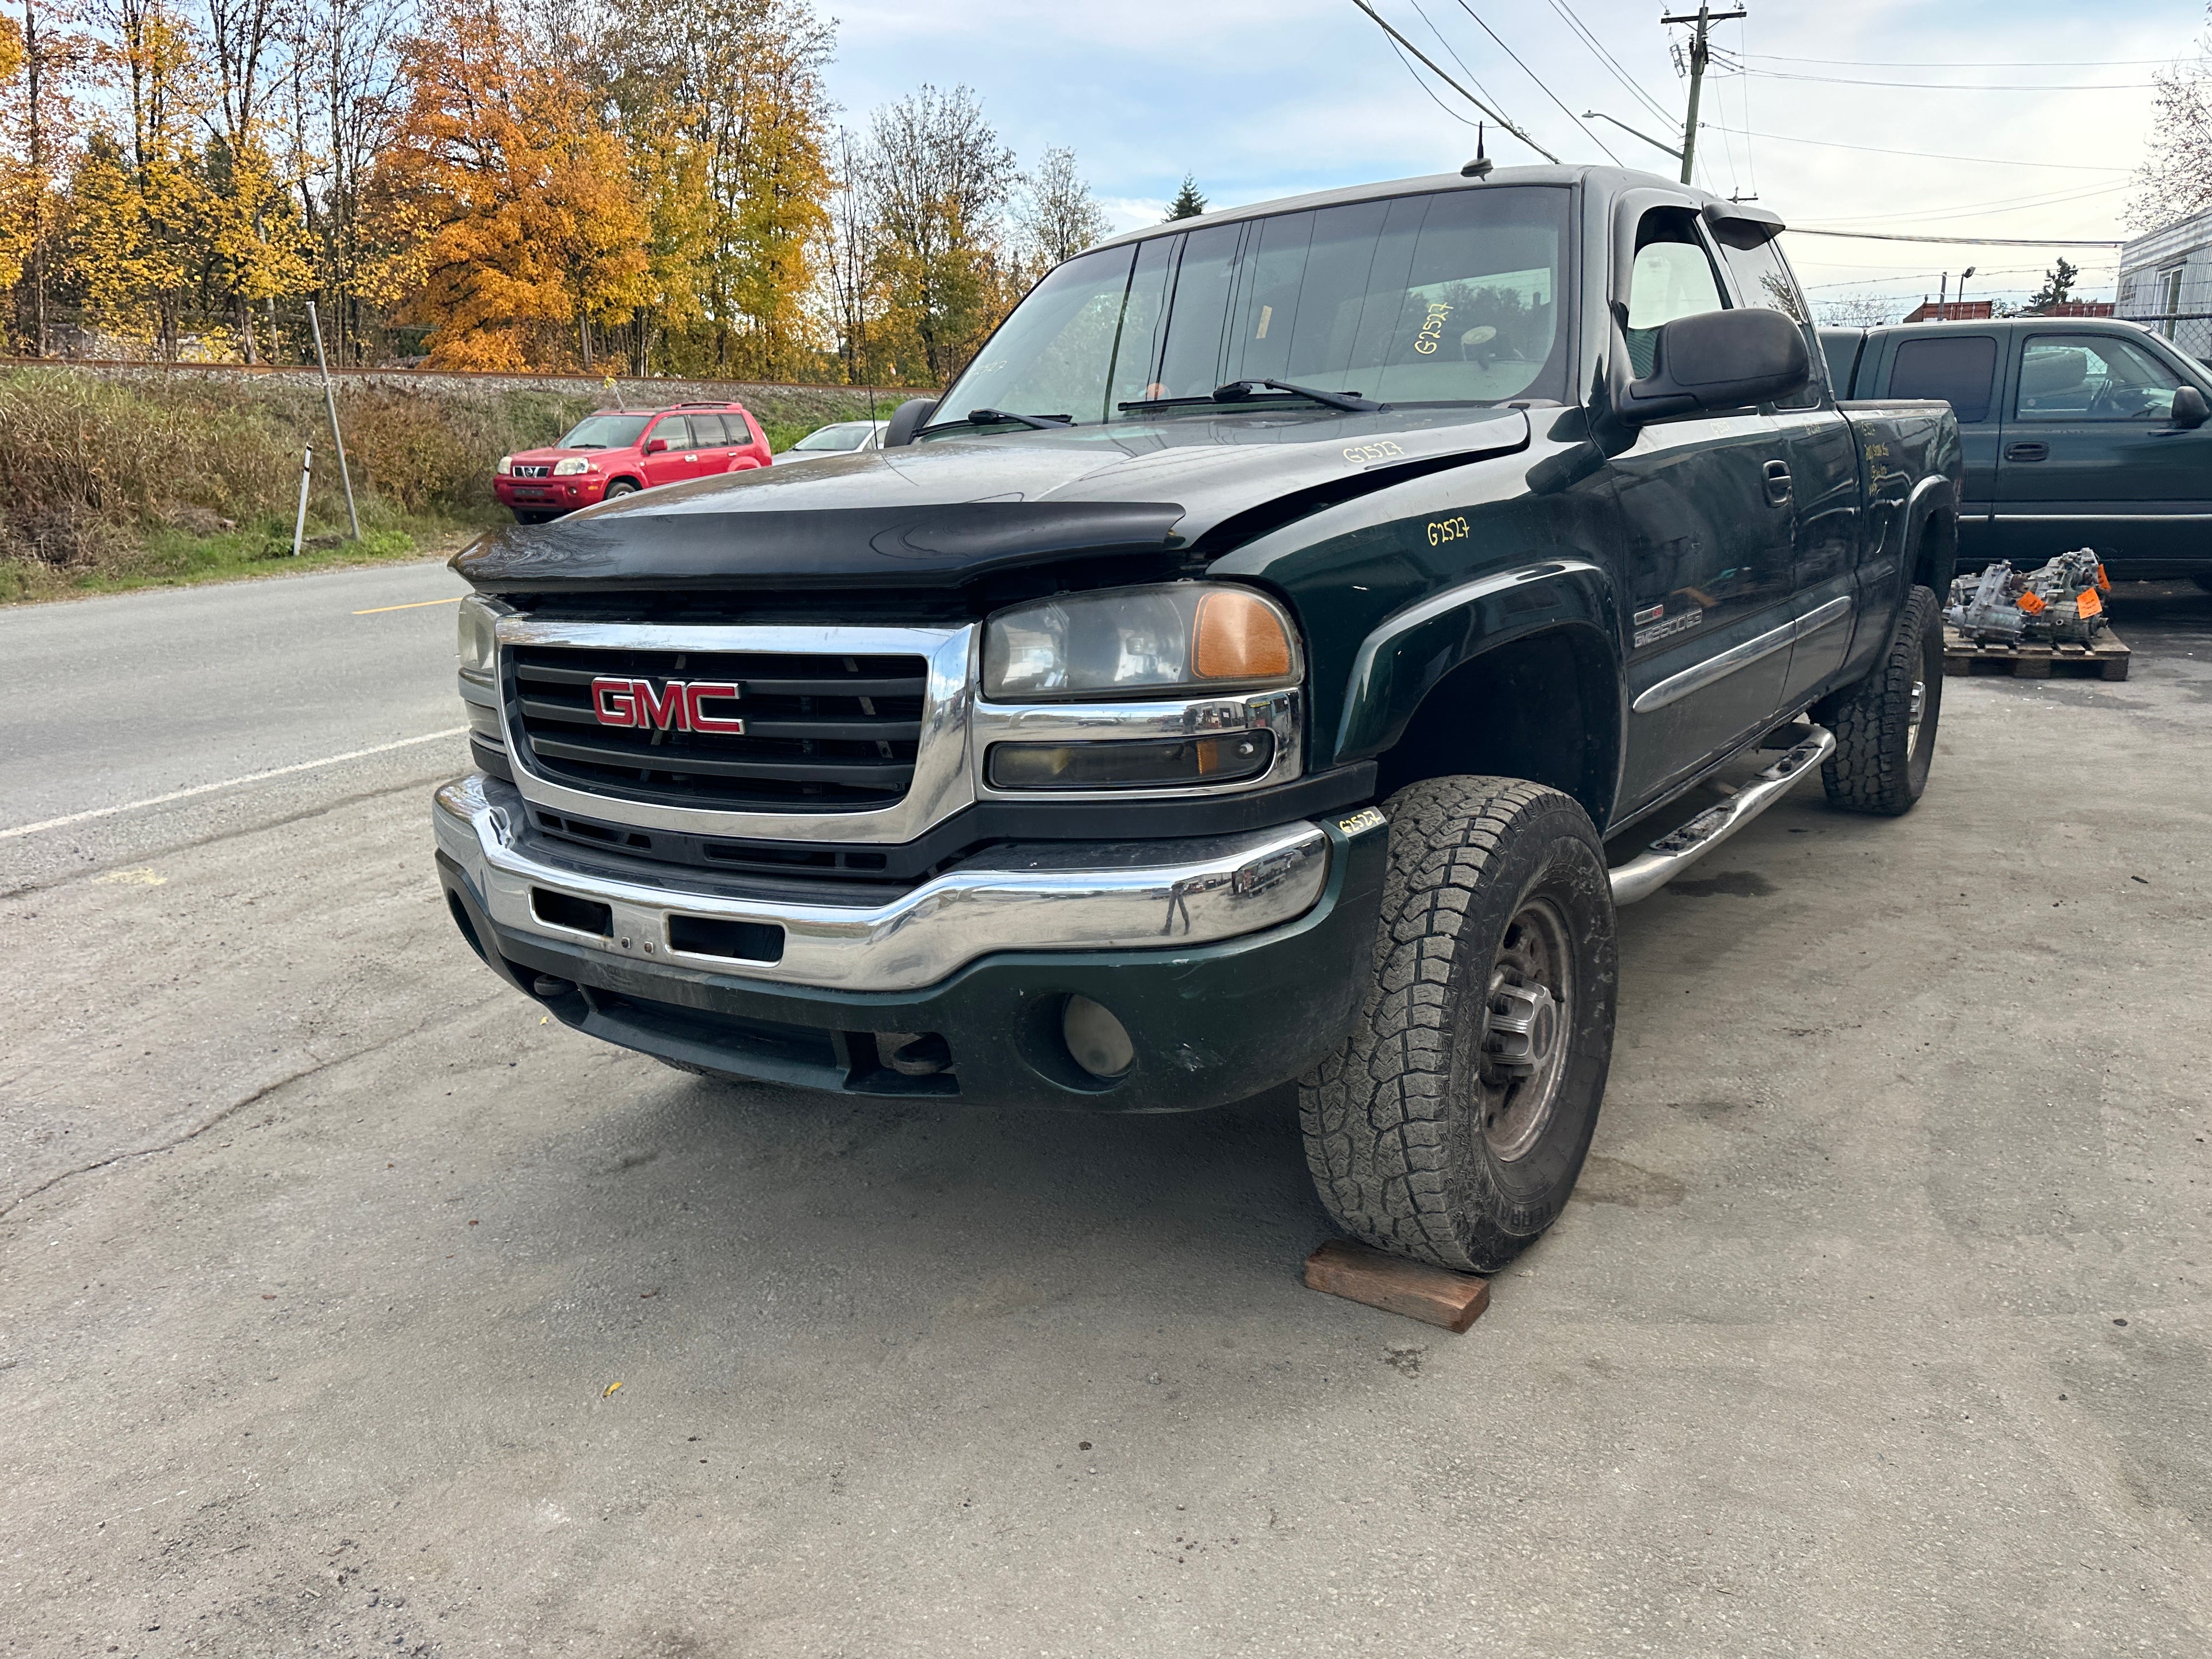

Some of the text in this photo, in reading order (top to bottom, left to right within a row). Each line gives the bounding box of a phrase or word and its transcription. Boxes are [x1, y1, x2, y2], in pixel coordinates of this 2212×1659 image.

[1414, 302, 1454, 354] G2527
[1343, 441, 1405, 463] G2527
[1427, 517, 1470, 546] G2527
[592, 677, 745, 734] GMC
[1339, 810, 1381, 834] G2527
